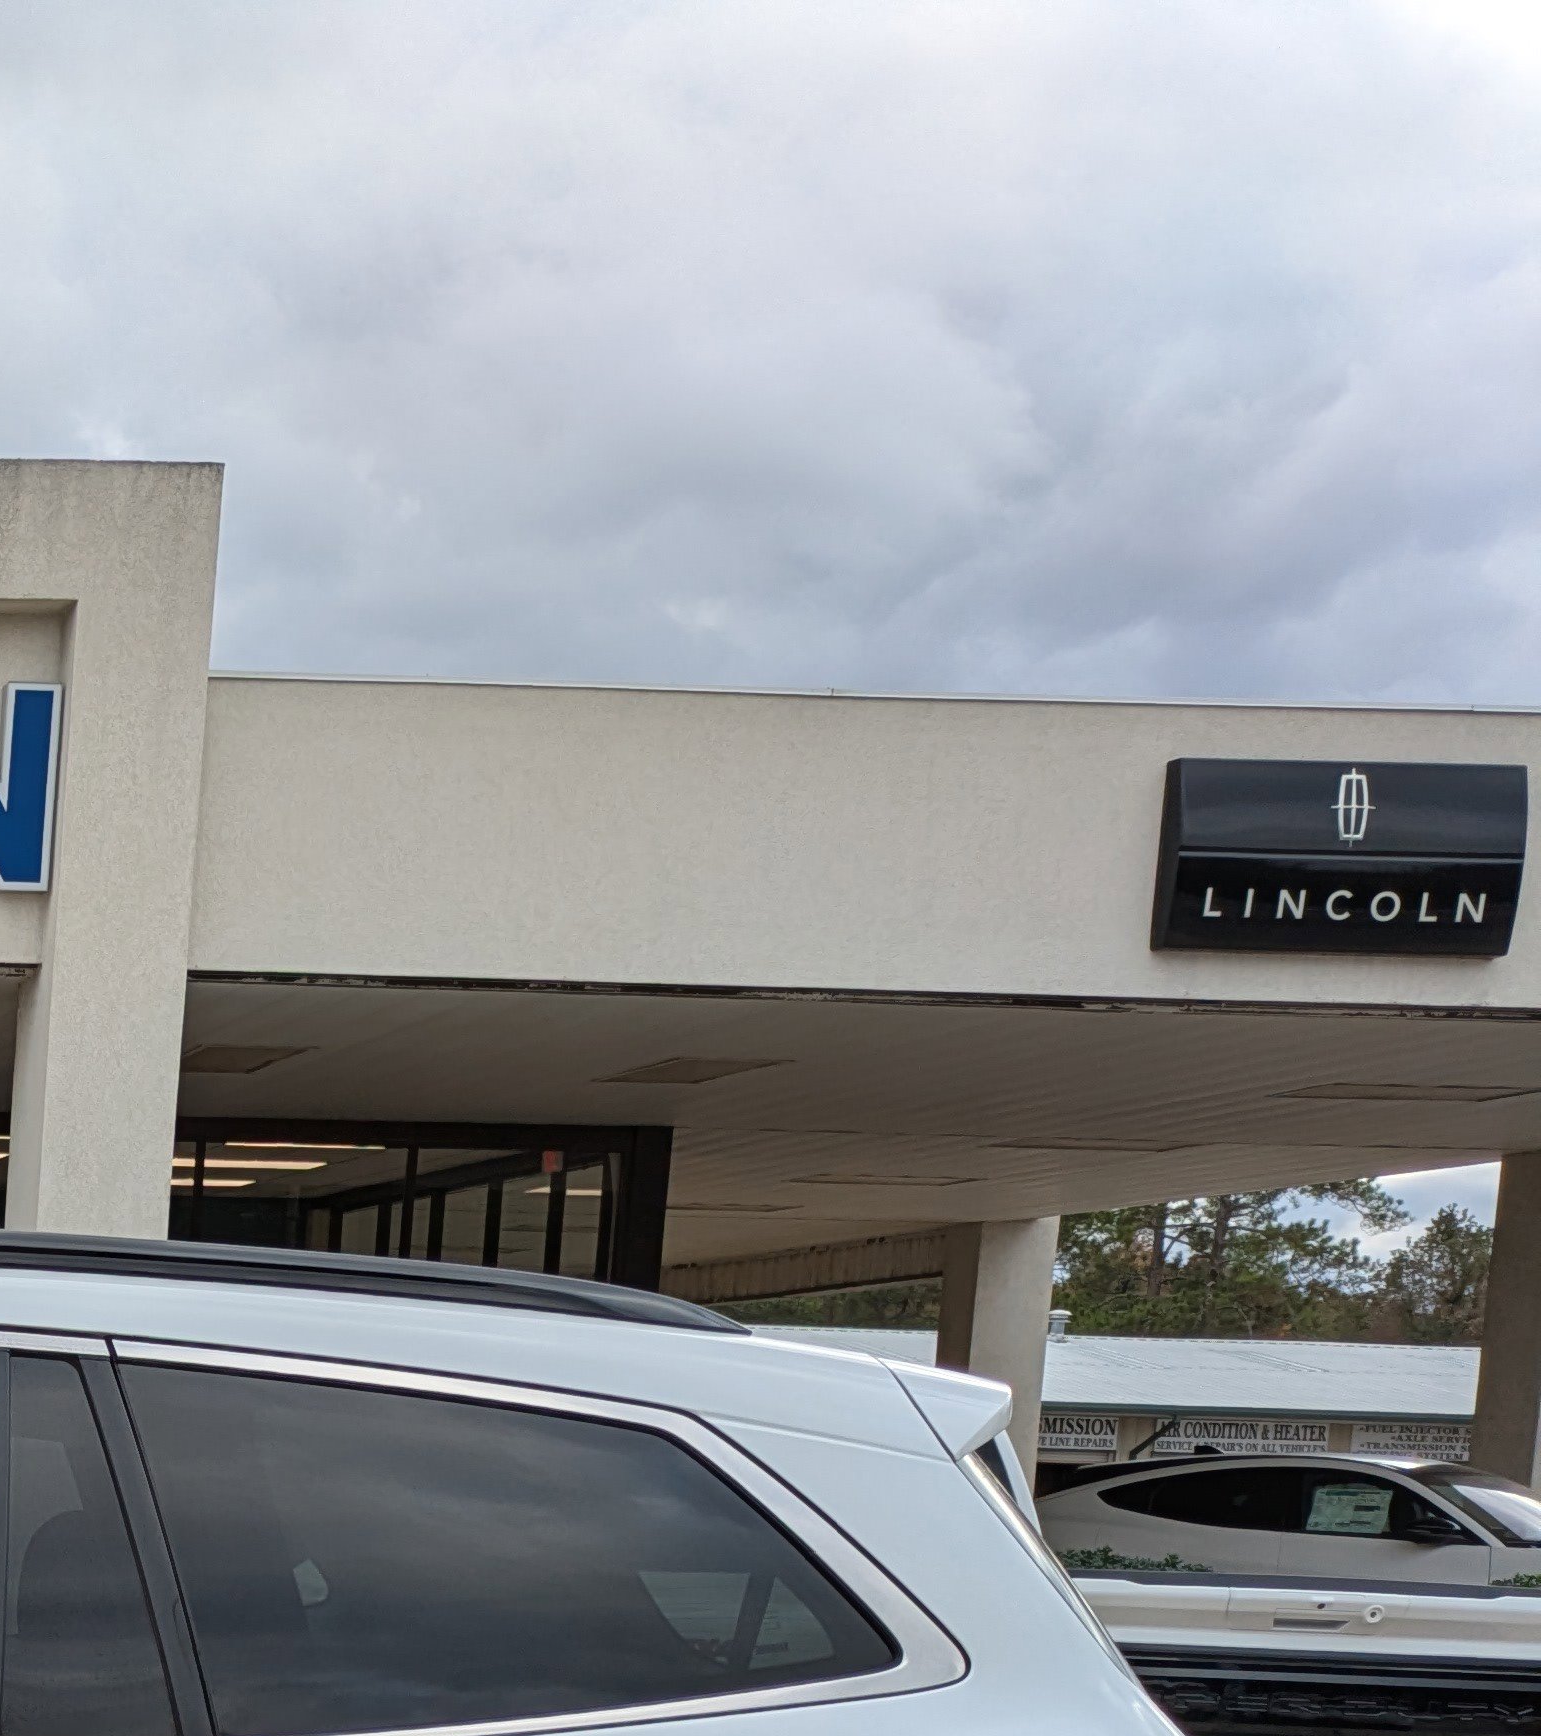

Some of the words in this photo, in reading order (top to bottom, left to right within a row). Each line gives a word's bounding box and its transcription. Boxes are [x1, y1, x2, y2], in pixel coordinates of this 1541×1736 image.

[1202, 886, 1487, 923] LINCOLN
[1184, 1421, 1259, 1440] CONDITION
[1261, 1424, 1270, 1440] &
[1273, 1423, 1327, 1442] HEATER
[1073, 1437, 1114, 1448] REPAIRS
